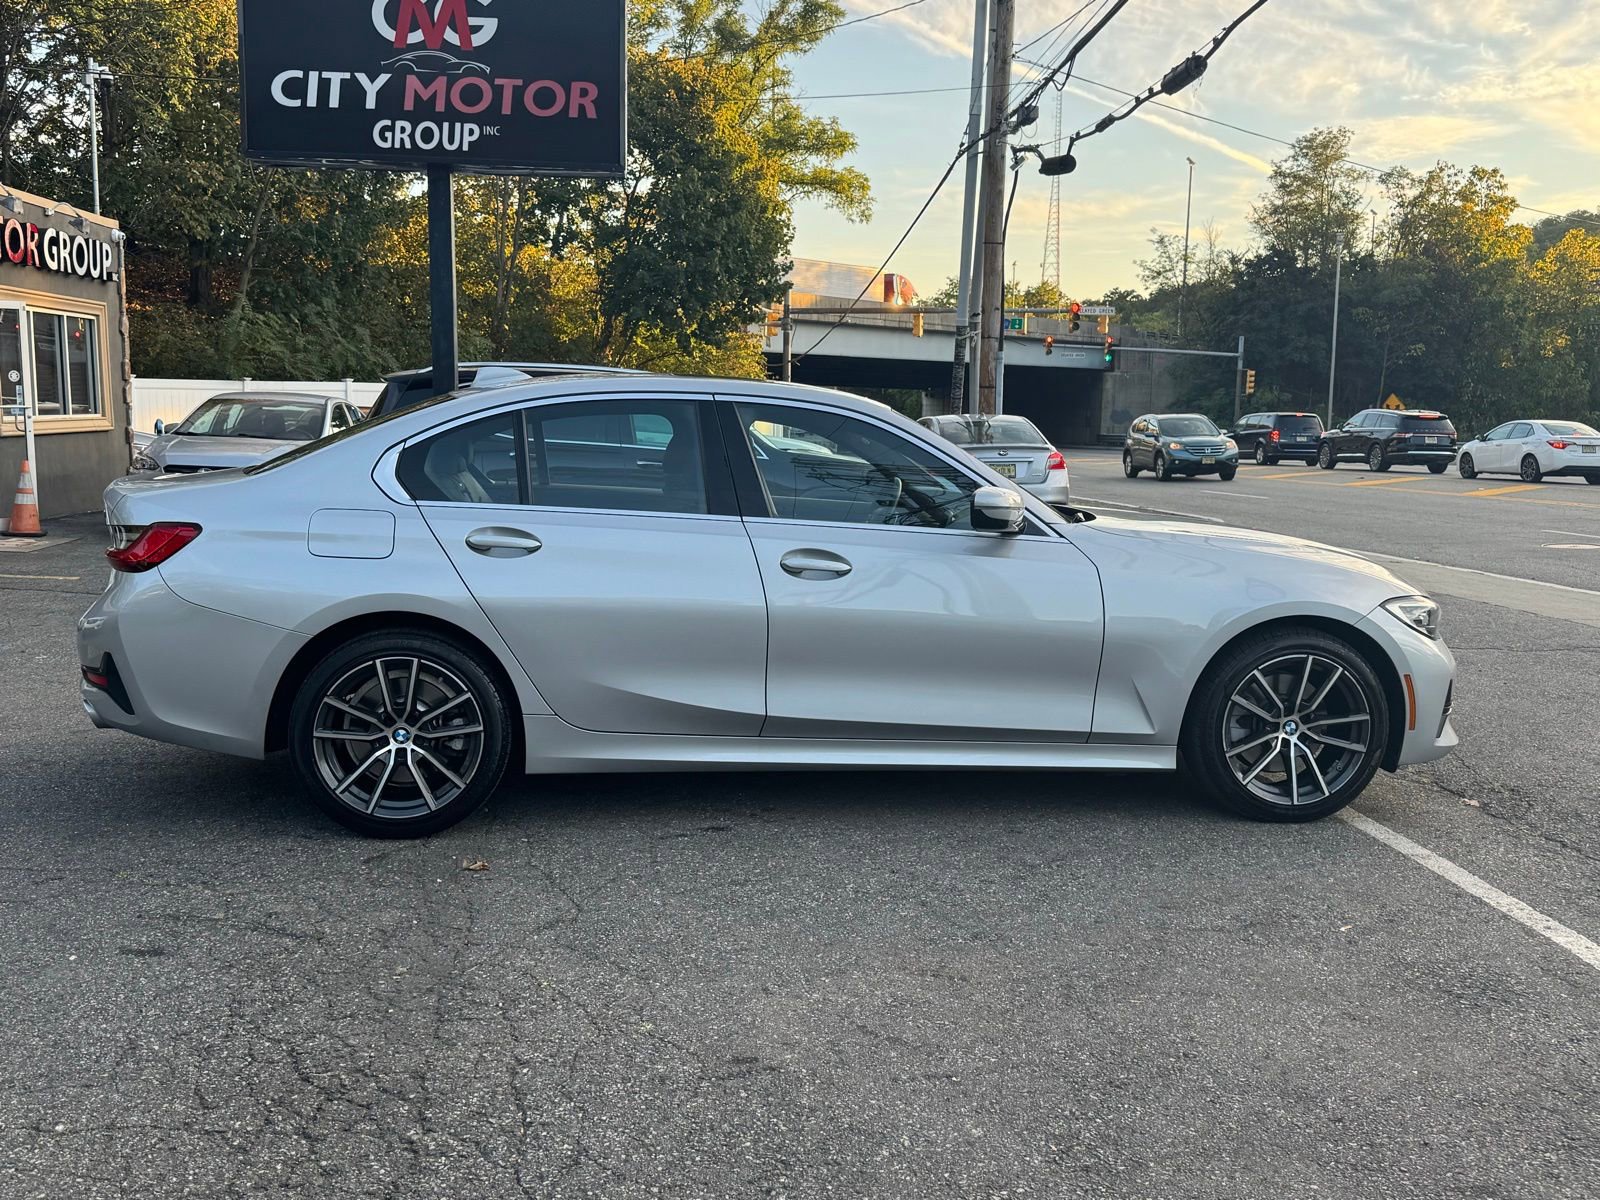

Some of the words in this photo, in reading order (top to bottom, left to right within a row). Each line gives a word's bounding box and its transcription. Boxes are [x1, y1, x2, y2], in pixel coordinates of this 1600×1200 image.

[270, 69, 392, 110] CITY
[403, 74, 599, 120] MOTOR
[372, 119, 480, 152] GROUP
[483, 125, 501, 136] INC
[0, 215, 40, 268] OR
[43, 227, 112, 281] GROUP
